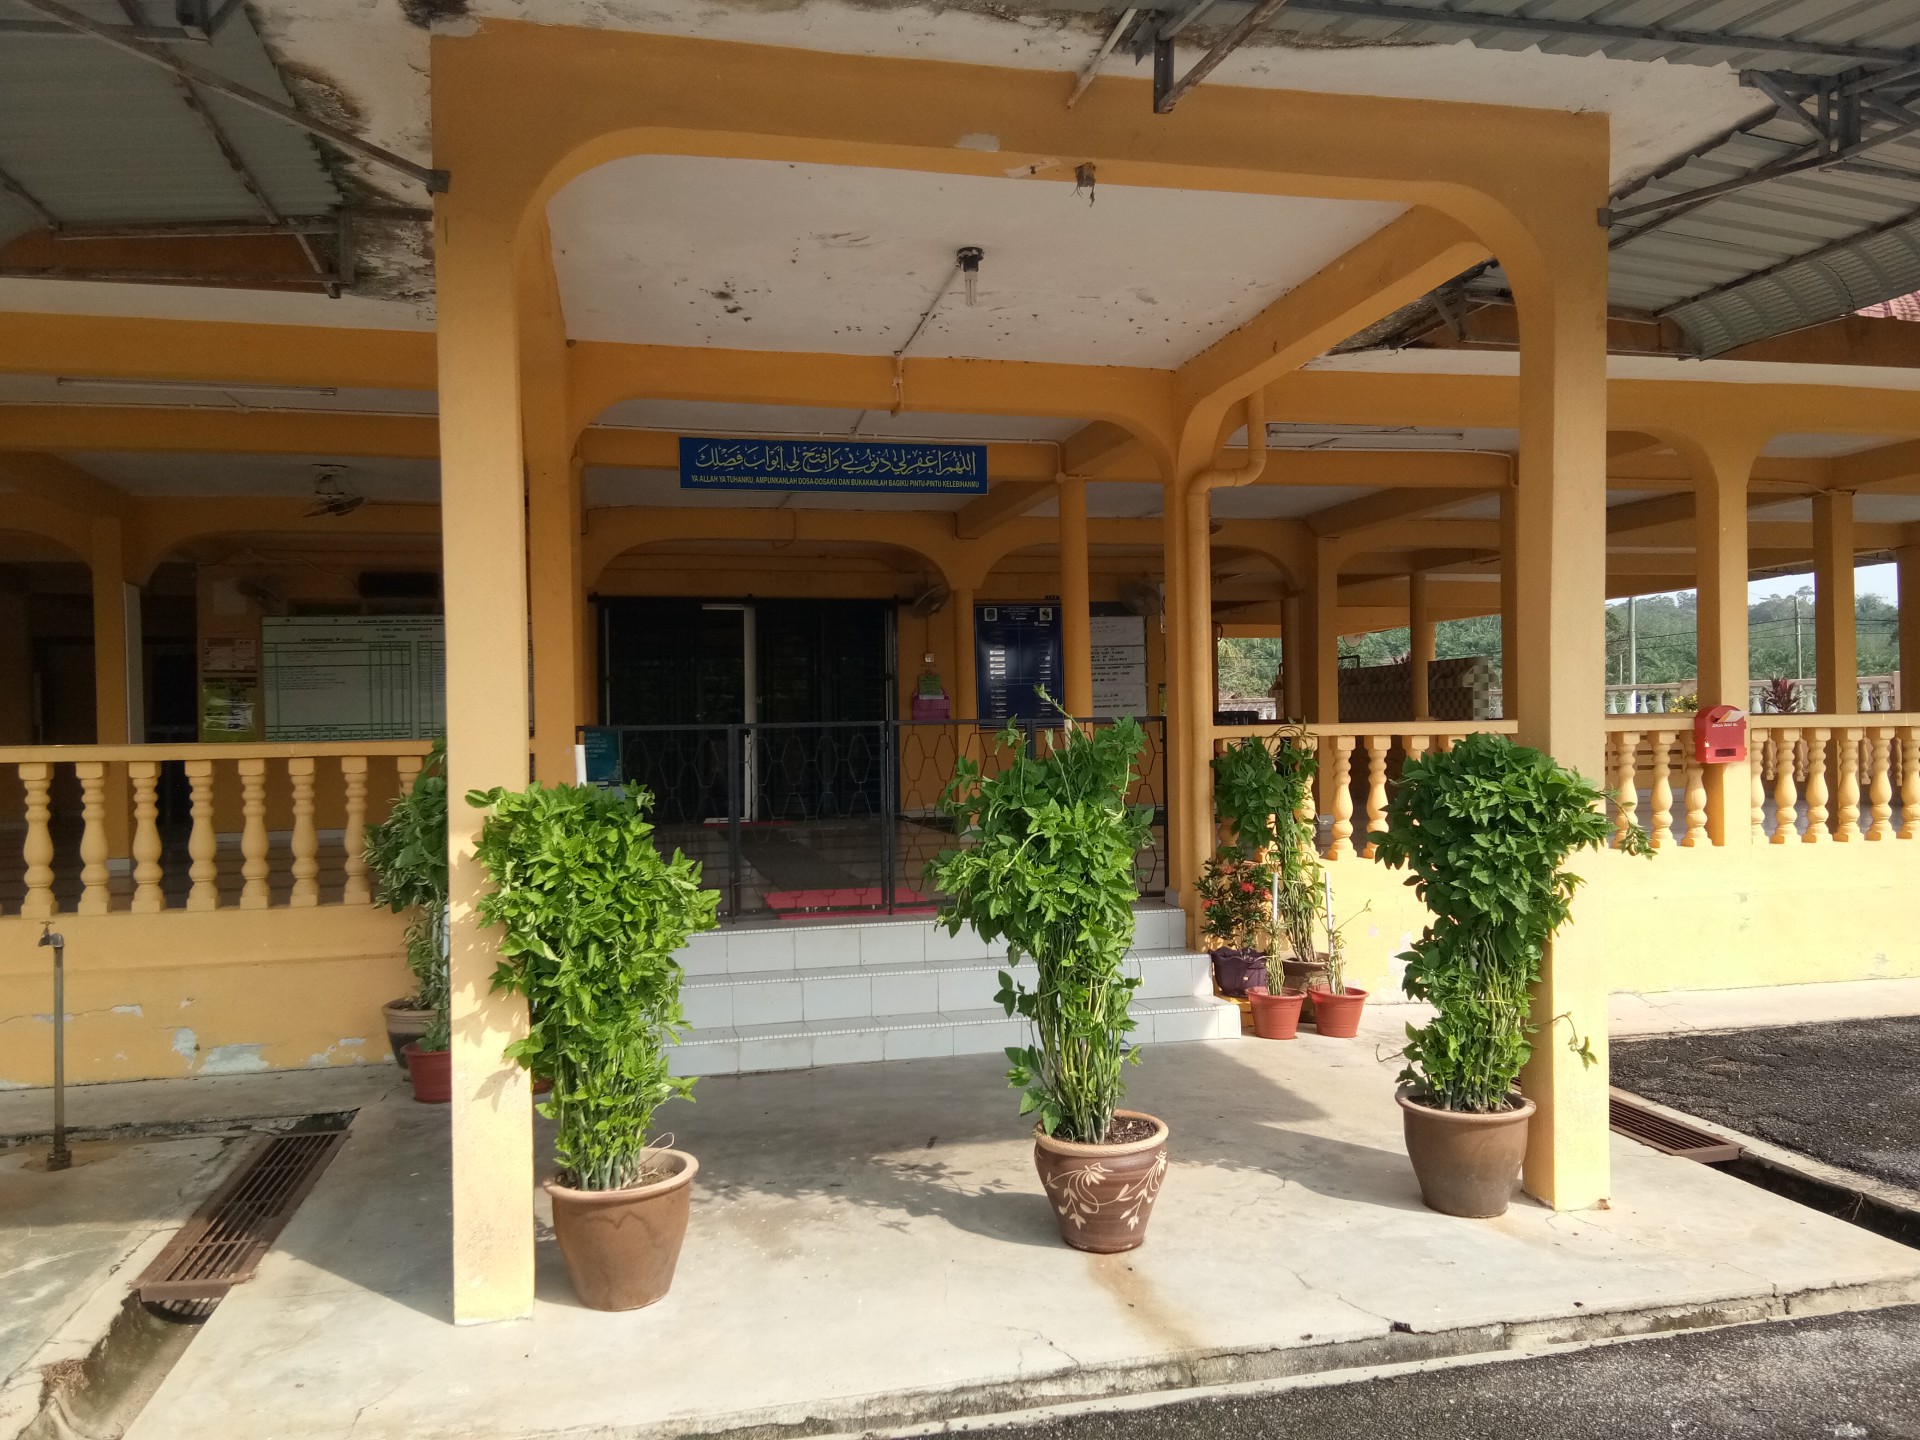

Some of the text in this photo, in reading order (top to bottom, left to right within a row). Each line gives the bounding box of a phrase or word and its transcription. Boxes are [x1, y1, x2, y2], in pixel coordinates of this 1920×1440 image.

[691, 474, 699, 482] YA
[699, 475, 719, 483] ALLAH
[719, 475, 727, 483] YA
[755, 476, 798, 485] AMPUNKANLAH
[838, 478, 851, 486] DAN
[851, 478, 888, 487] BUKAKANLAH
[888, 479, 909, 487] BAGIKU
[909, 480, 942, 488] PINTU-PINTU
[942, 480, 980, 488] KELEBIHANMU
